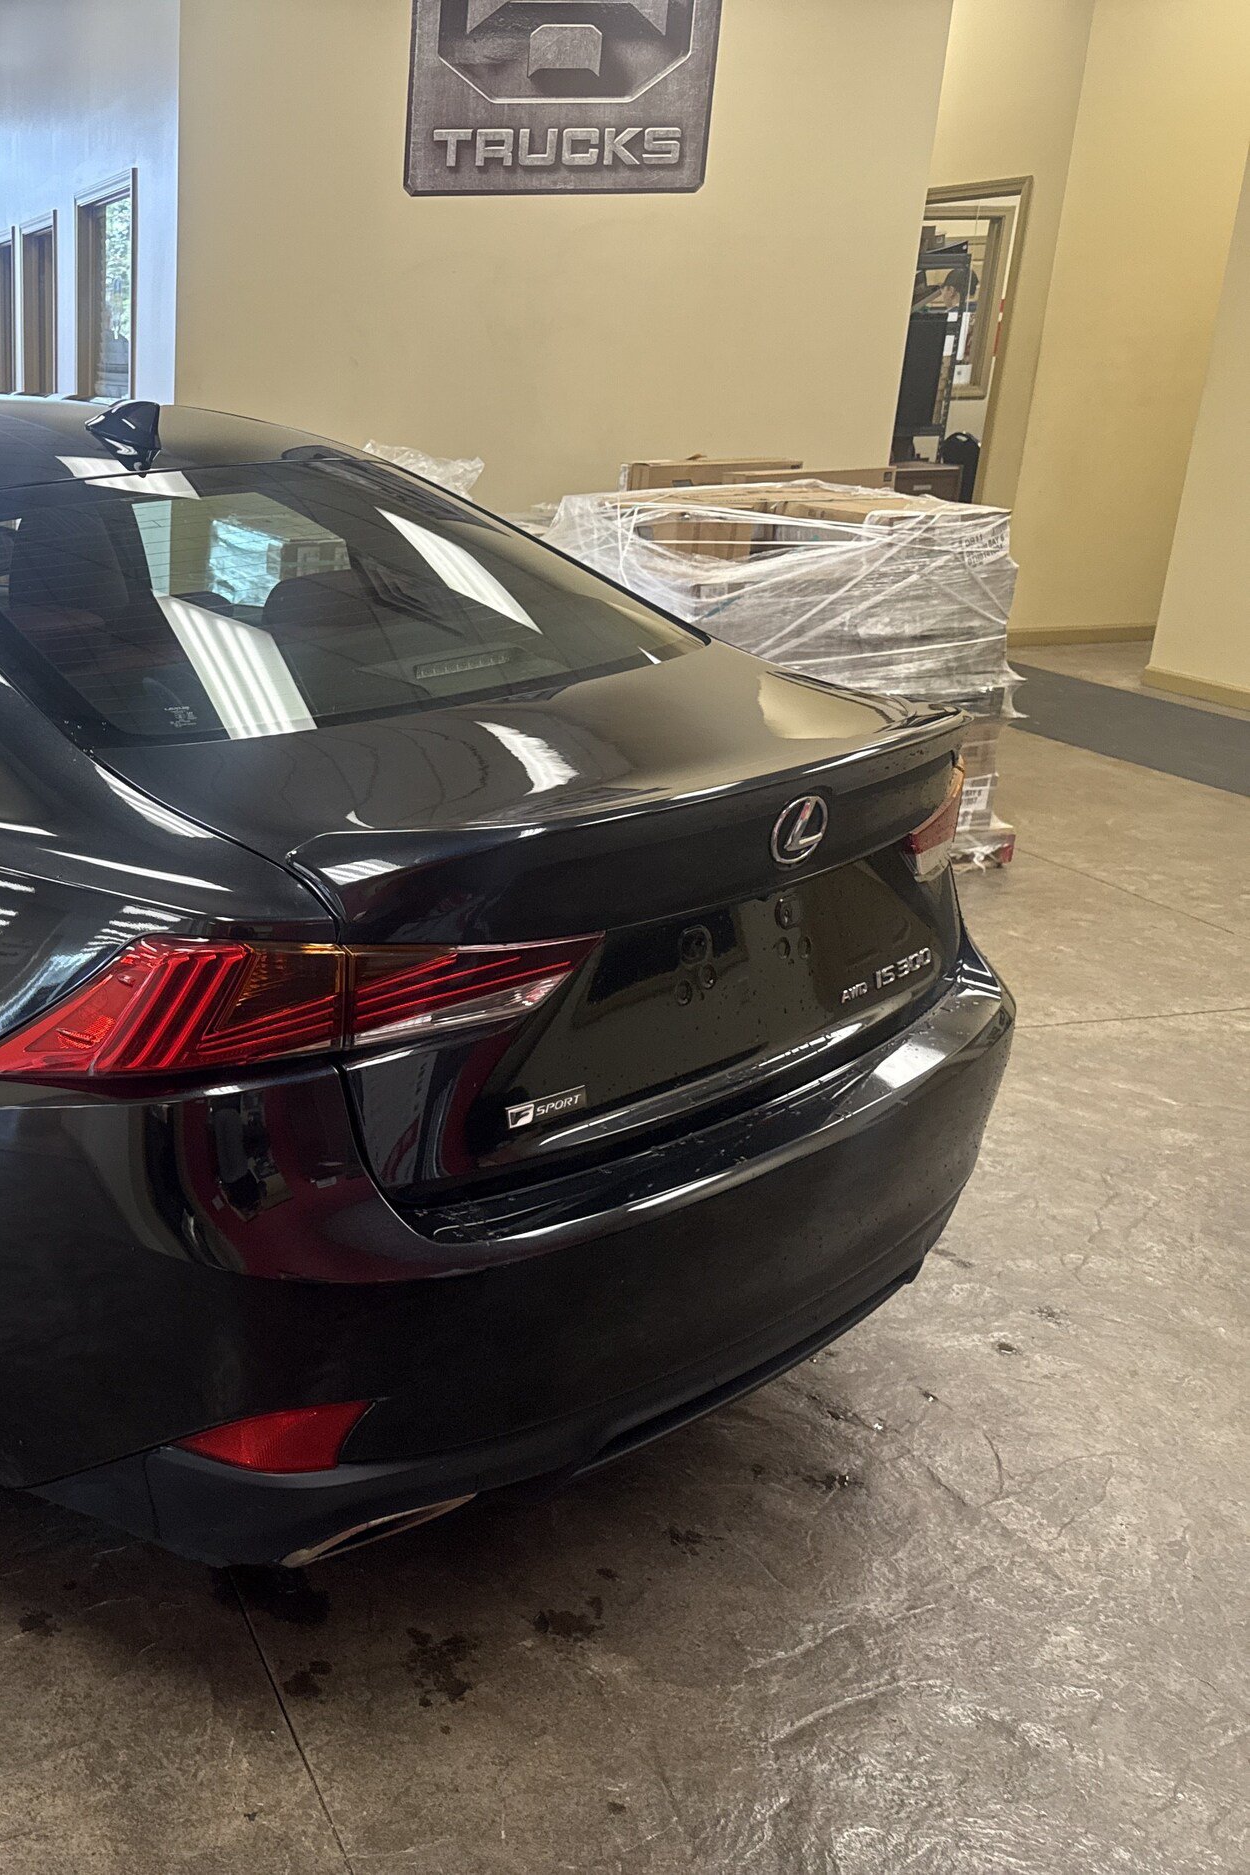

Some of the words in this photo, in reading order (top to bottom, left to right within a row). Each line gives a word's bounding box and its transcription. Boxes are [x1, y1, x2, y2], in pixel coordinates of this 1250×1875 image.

[433, 126, 682, 168] TRUCKS
[841, 981, 868, 1004] AWD
[874, 964, 896, 990] IS
[896, 947, 932, 978] 300
[535, 1093, 582, 1117] SPORT
